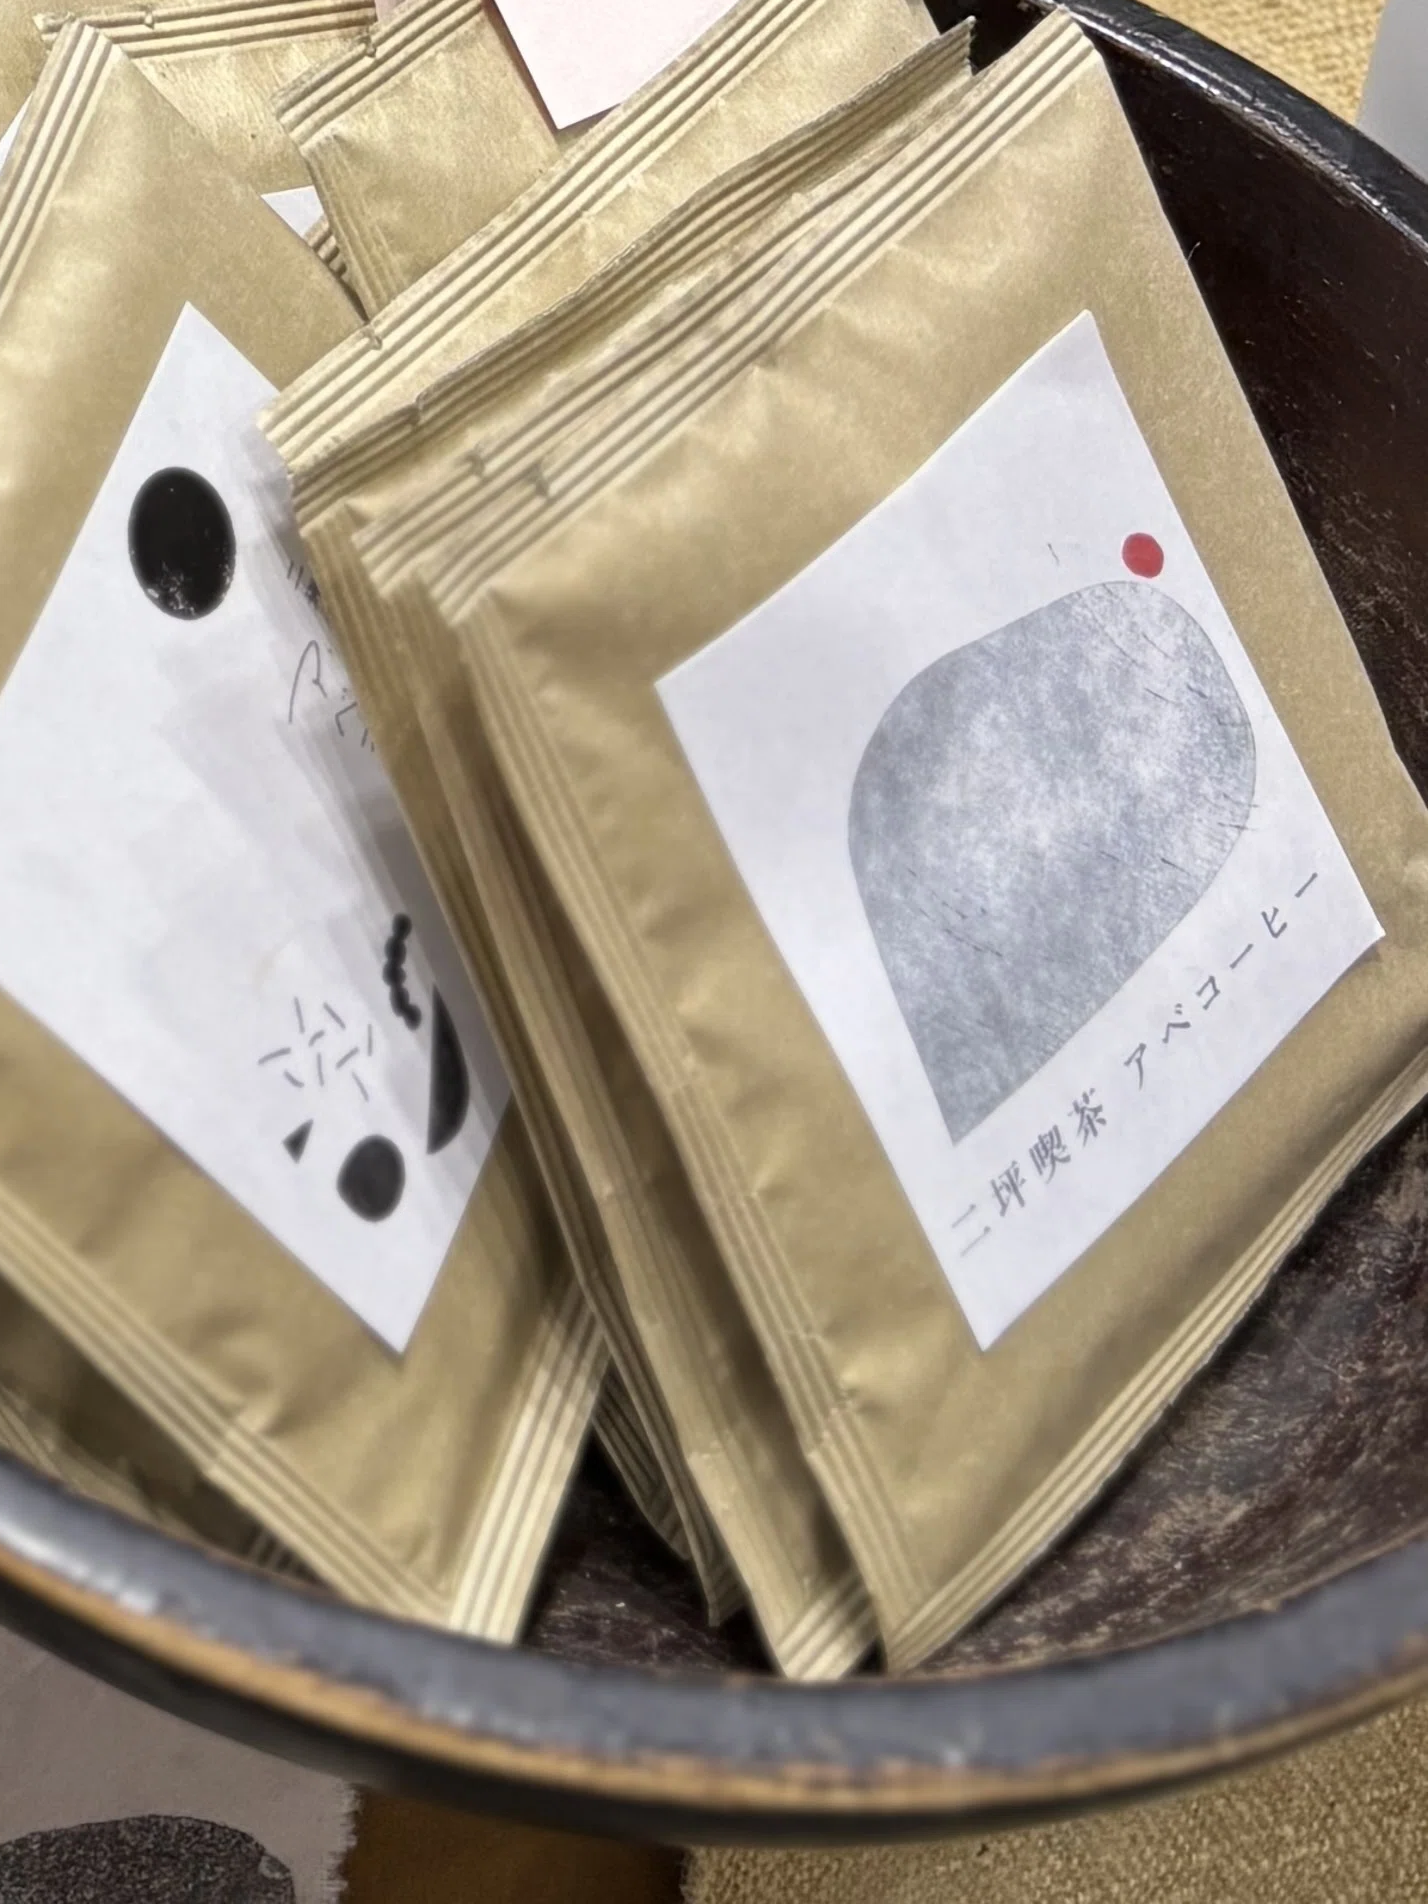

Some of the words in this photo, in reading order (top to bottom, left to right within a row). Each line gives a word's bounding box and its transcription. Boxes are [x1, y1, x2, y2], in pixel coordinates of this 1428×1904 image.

[951, 1087, 1108, 1258] 二坪喫茶
[1123, 872, 1319, 1091] アベコーヒー
